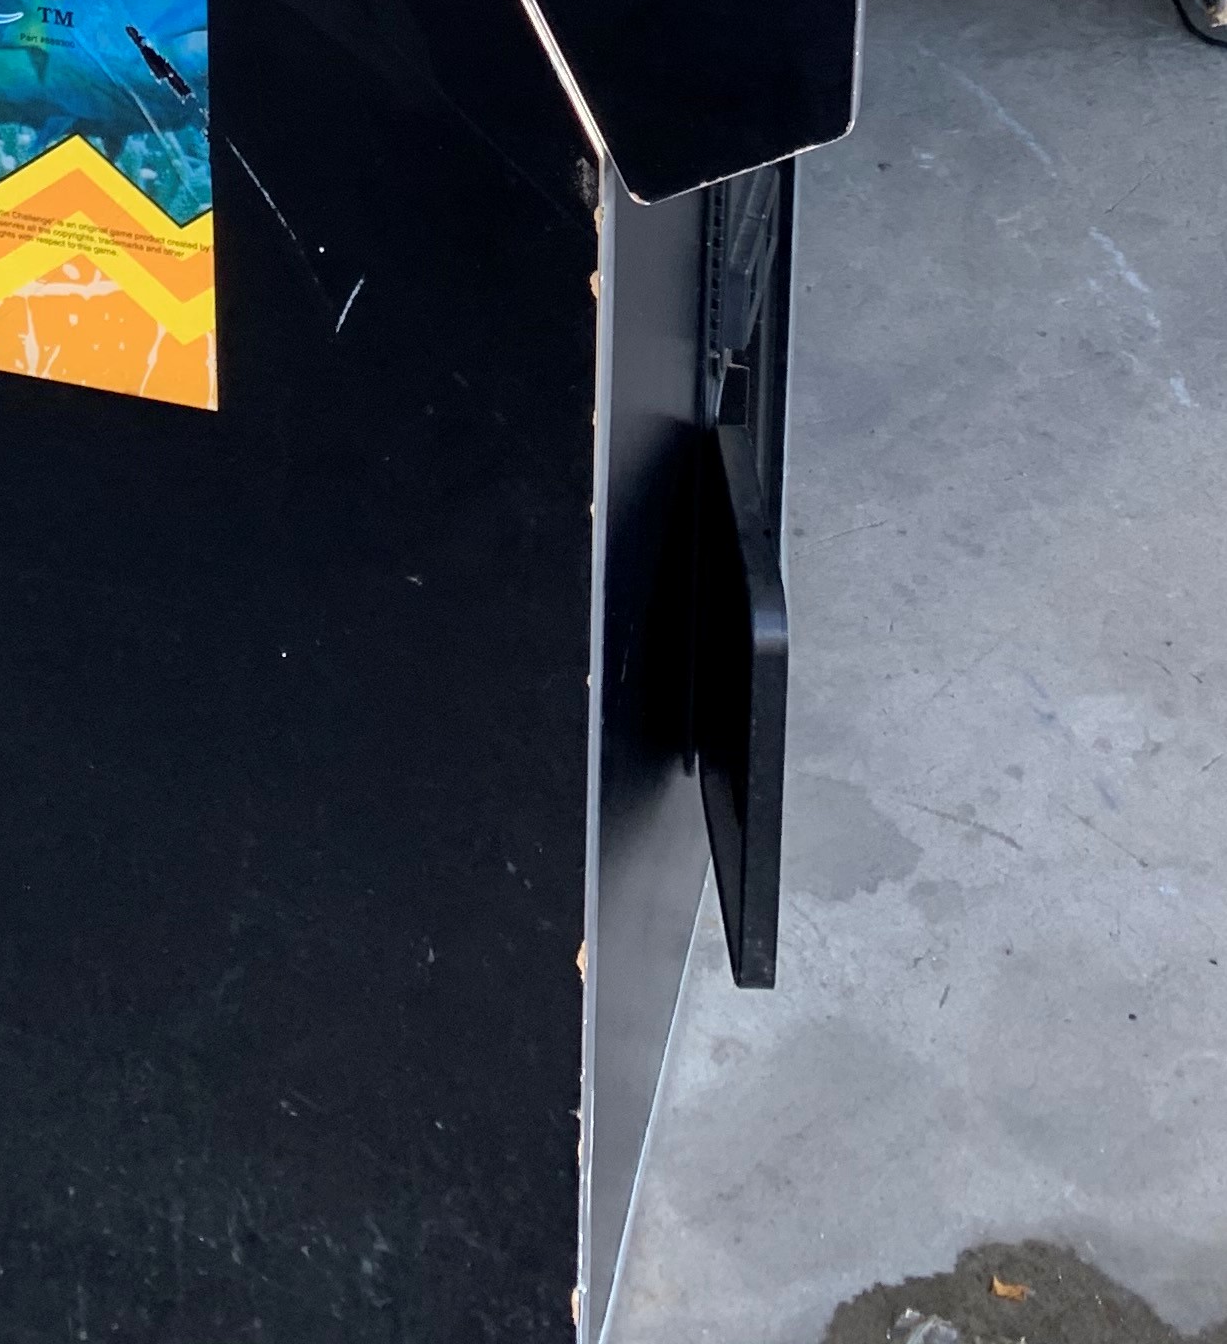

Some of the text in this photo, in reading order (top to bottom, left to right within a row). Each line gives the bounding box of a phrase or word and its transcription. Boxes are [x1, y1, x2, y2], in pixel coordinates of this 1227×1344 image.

[36, 6, 75, 29] TM
[77, 222, 109, 236] original
[109, 227, 134, 240] game
[134, 231, 166, 245] product
[166, 237, 199, 251] created
[199, 242, 211, 254] by
[145, 244, 162, 255] and
